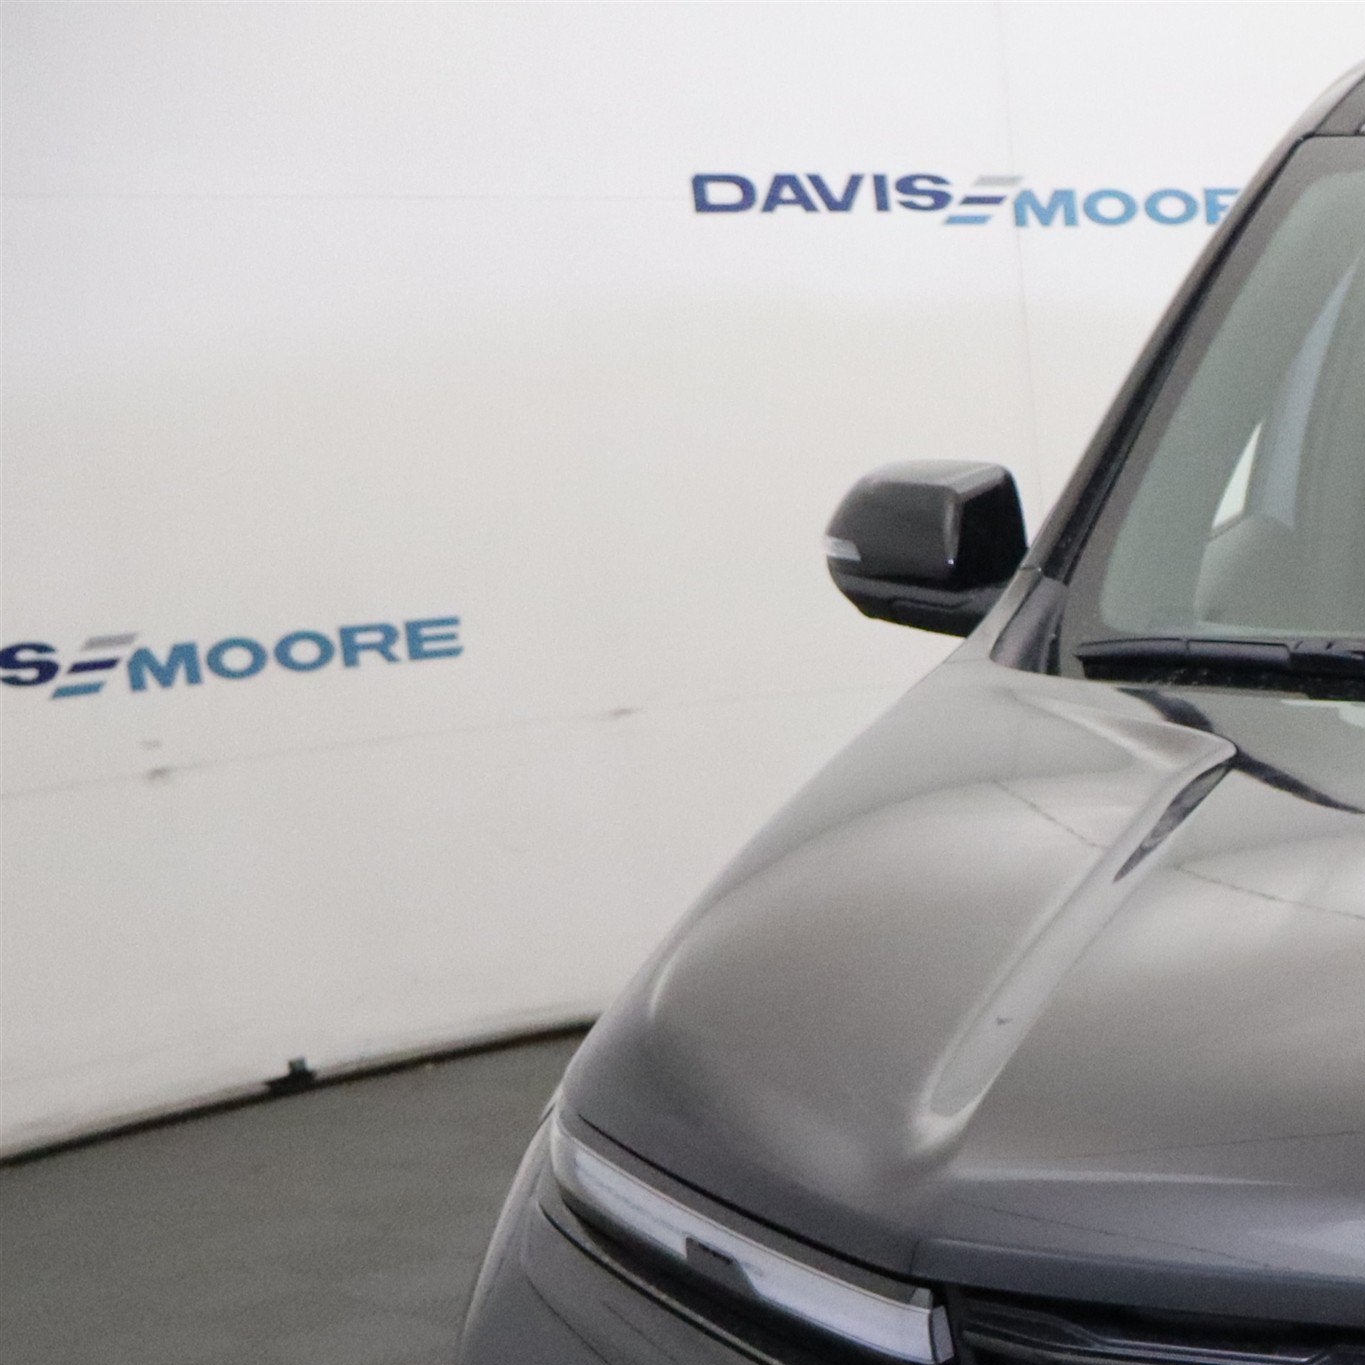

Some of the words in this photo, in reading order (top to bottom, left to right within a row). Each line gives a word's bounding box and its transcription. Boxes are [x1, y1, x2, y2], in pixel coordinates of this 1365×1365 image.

[691, 173, 954, 212] DAVIS
[1013, 187, 1242, 226] MOO
[127, 615, 463, 692] MOORE
